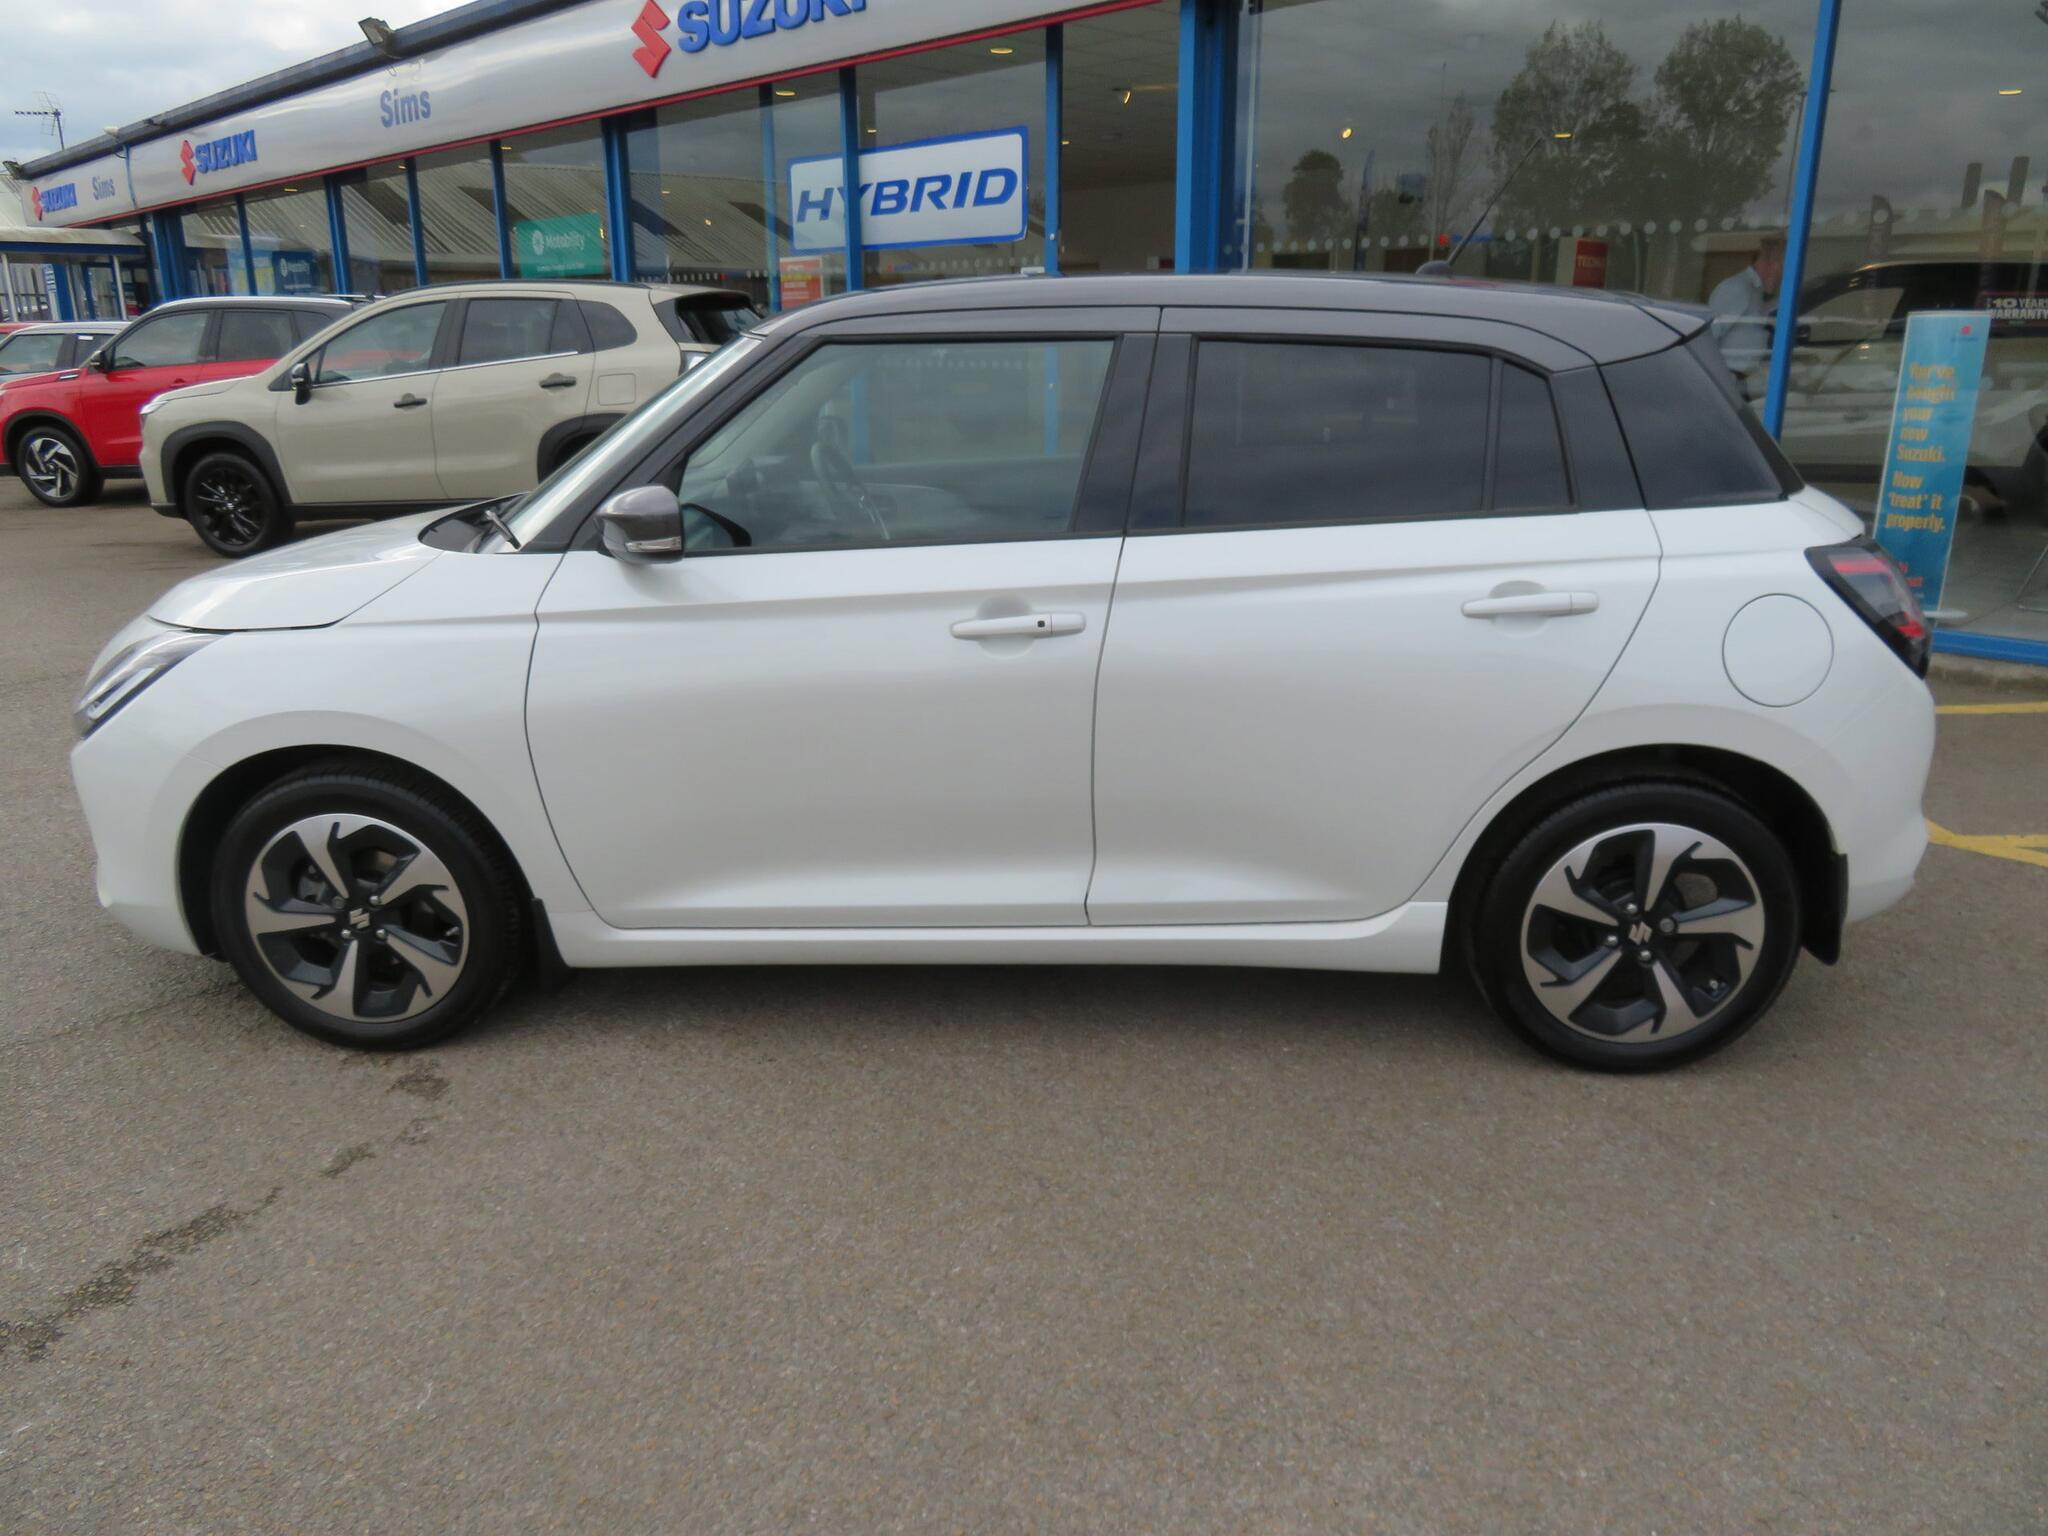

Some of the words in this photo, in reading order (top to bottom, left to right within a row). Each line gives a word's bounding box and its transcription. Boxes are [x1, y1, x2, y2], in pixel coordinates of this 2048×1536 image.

[678, 0, 867, 53] SUZU
[380, 88, 432, 128] Sims
[195, 129, 258, 174] SUZUKI
[40, 182, 78, 214] SUZUKI
[91, 175, 116, 201] Sims
[797, 167, 1019, 223] HYBRID
[1884, 513, 1946, 533] properly.
